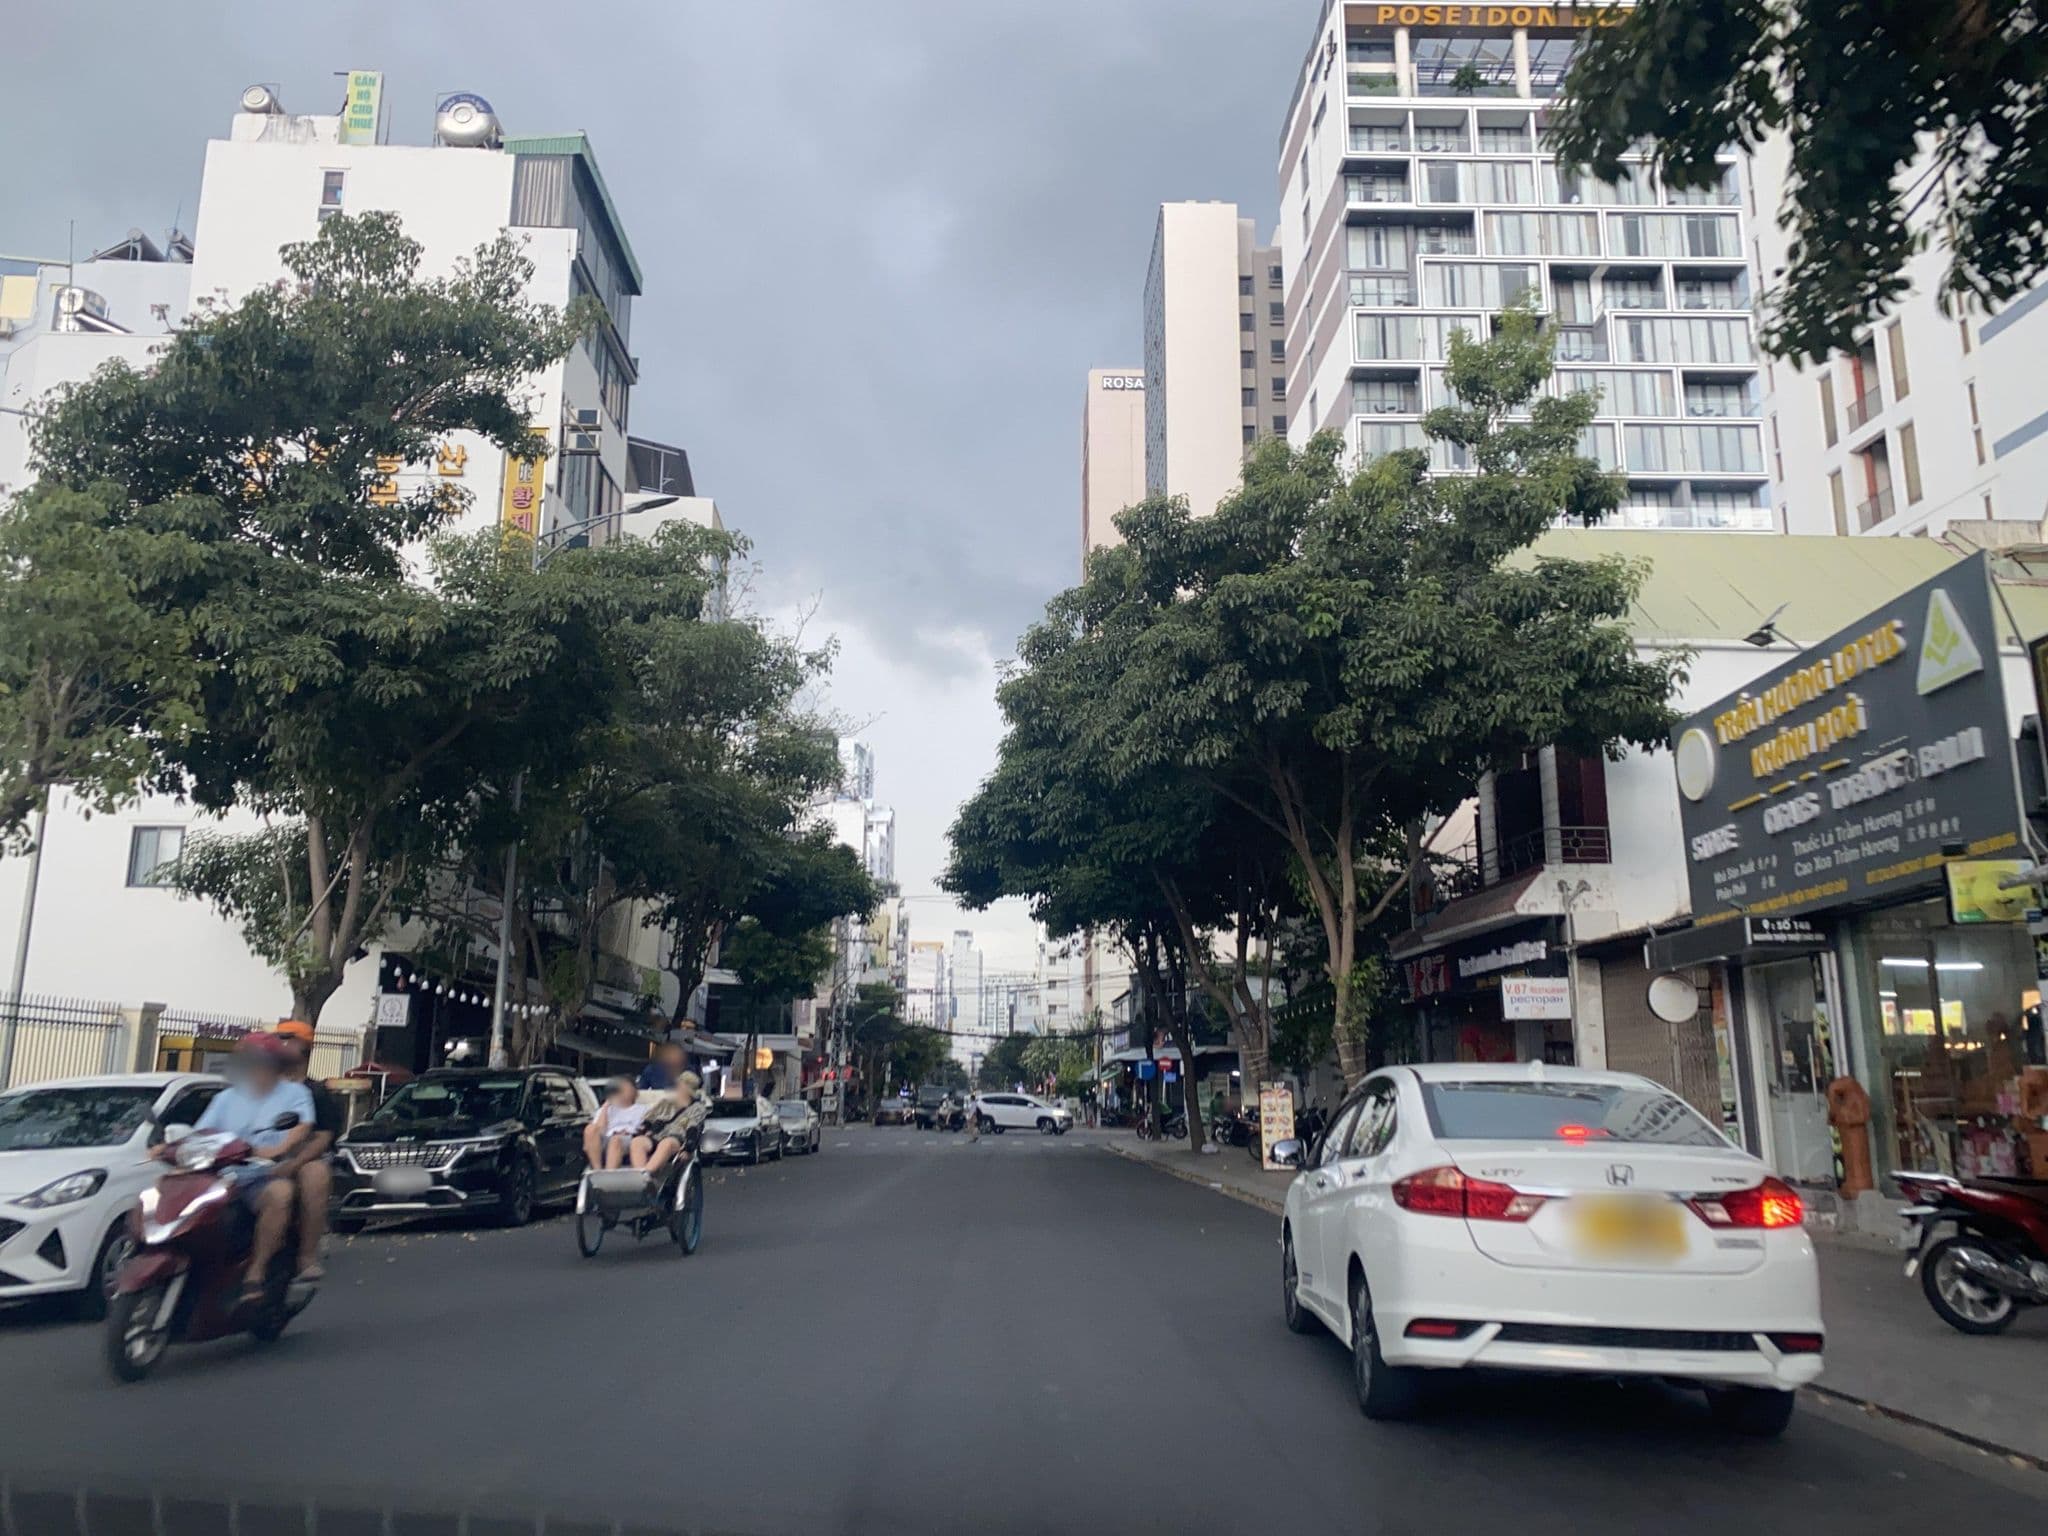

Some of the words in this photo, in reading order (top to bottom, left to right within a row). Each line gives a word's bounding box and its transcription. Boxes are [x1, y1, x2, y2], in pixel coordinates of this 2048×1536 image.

[1377, 5, 1556, 26] POSEIDON
[1103, 377, 1144, 389] ROSA
[1831, 619, 1906, 684] LOTUS
